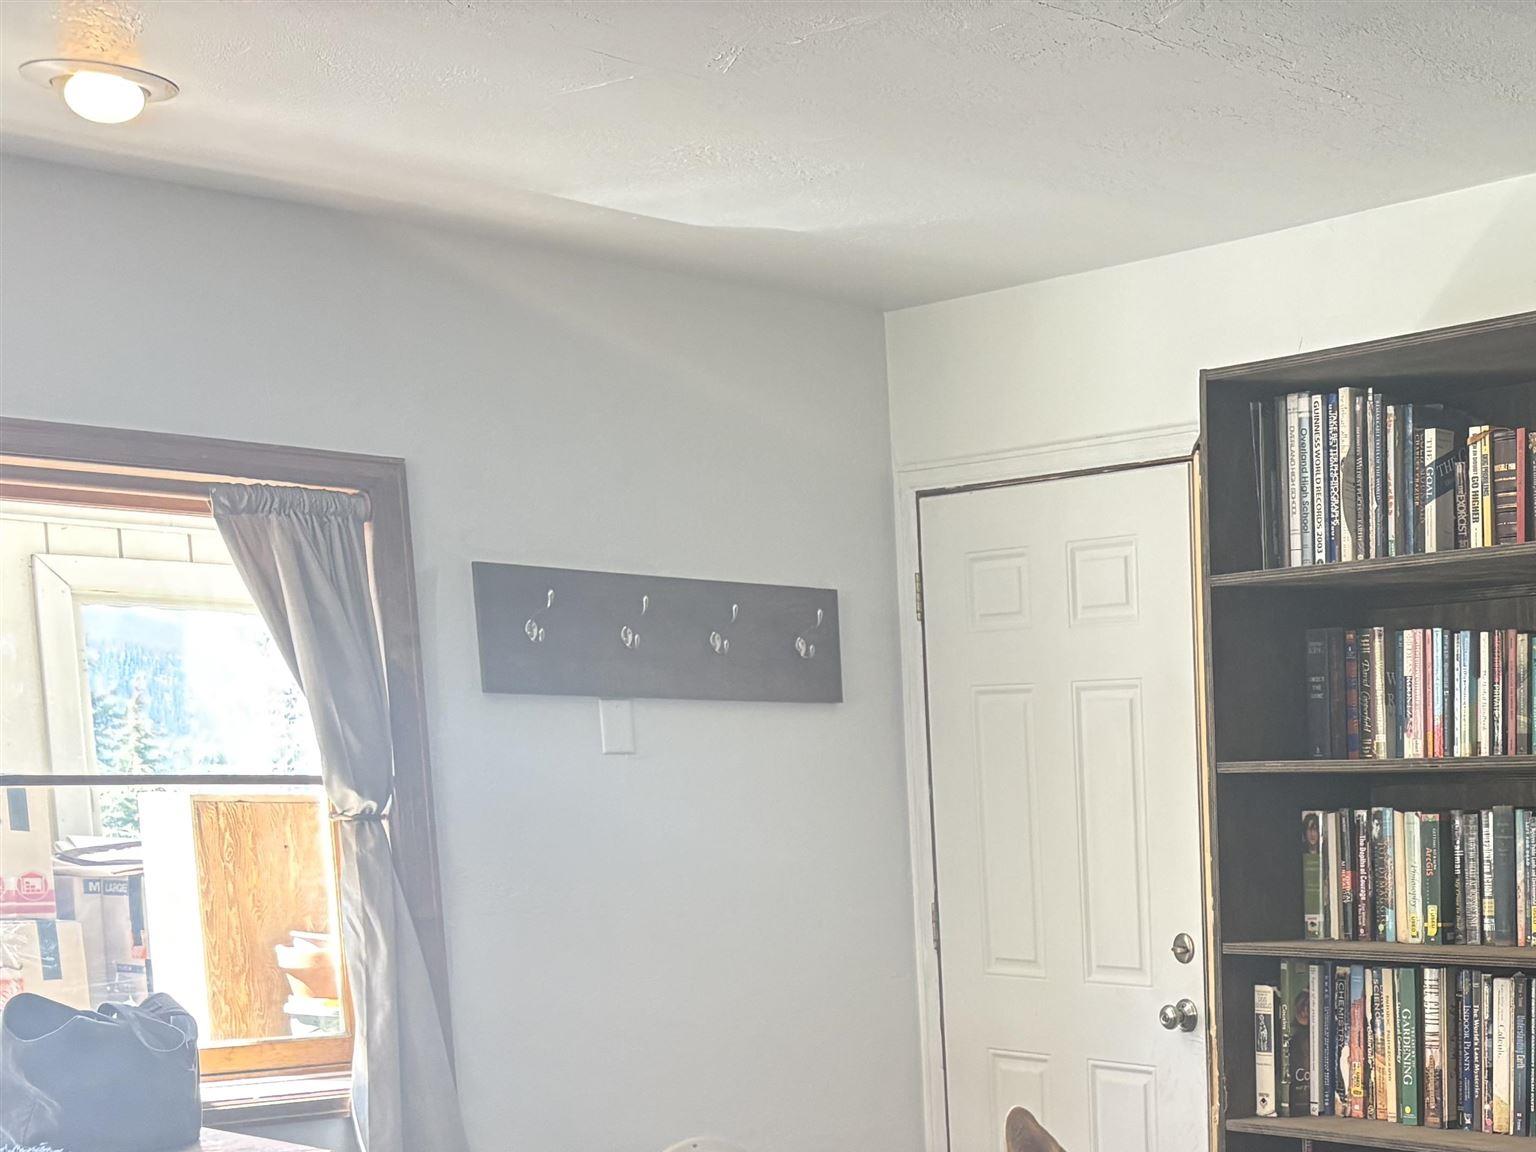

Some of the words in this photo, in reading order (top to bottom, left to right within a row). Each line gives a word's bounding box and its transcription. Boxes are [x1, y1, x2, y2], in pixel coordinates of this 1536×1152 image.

[1313, 400, 1321, 448] GUINNESS
[1300, 428, 1309, 475] Overland
[1314, 449, 1322, 485] WORLD
[1300, 476, 1310, 498] High
[1332, 464, 1340, 526] PHOTOGRAPHS
[1426, 466, 1434, 500] GOAL
[1471, 475, 1480, 489] GO
[1302, 500, 1310, 534] School
[1315, 486, 1323, 530] RECORDS
[1456, 494, 1468, 536] EXORCIST
[1472, 490, 1480, 524] HIGHER
[1316, 532, 1324, 554] 2003
[1361, 659, 1370, 688] David
[1361, 690, 1372, 734] Copperfield
[1358, 846, 1367, 867] Depths
[1425, 847, 1434, 877] ArcGIS
[88, 881, 100, 892] M
[104, 882, 128, 893] LARGE
[1359, 875, 1368, 901] Courage
[1409, 864, 1420, 908] Philosophy
[1463, 1004, 1471, 1039] INDOOR
[1516, 1014, 1526, 1054] Understanding
[1402, 1008, 1413, 1086] GARDENING
[1463, 1040, 1472, 1072] PLANTS
[1516, 1054, 1526, 1069] Earth
[1472, 1063, 1480, 1099] Mysteries
